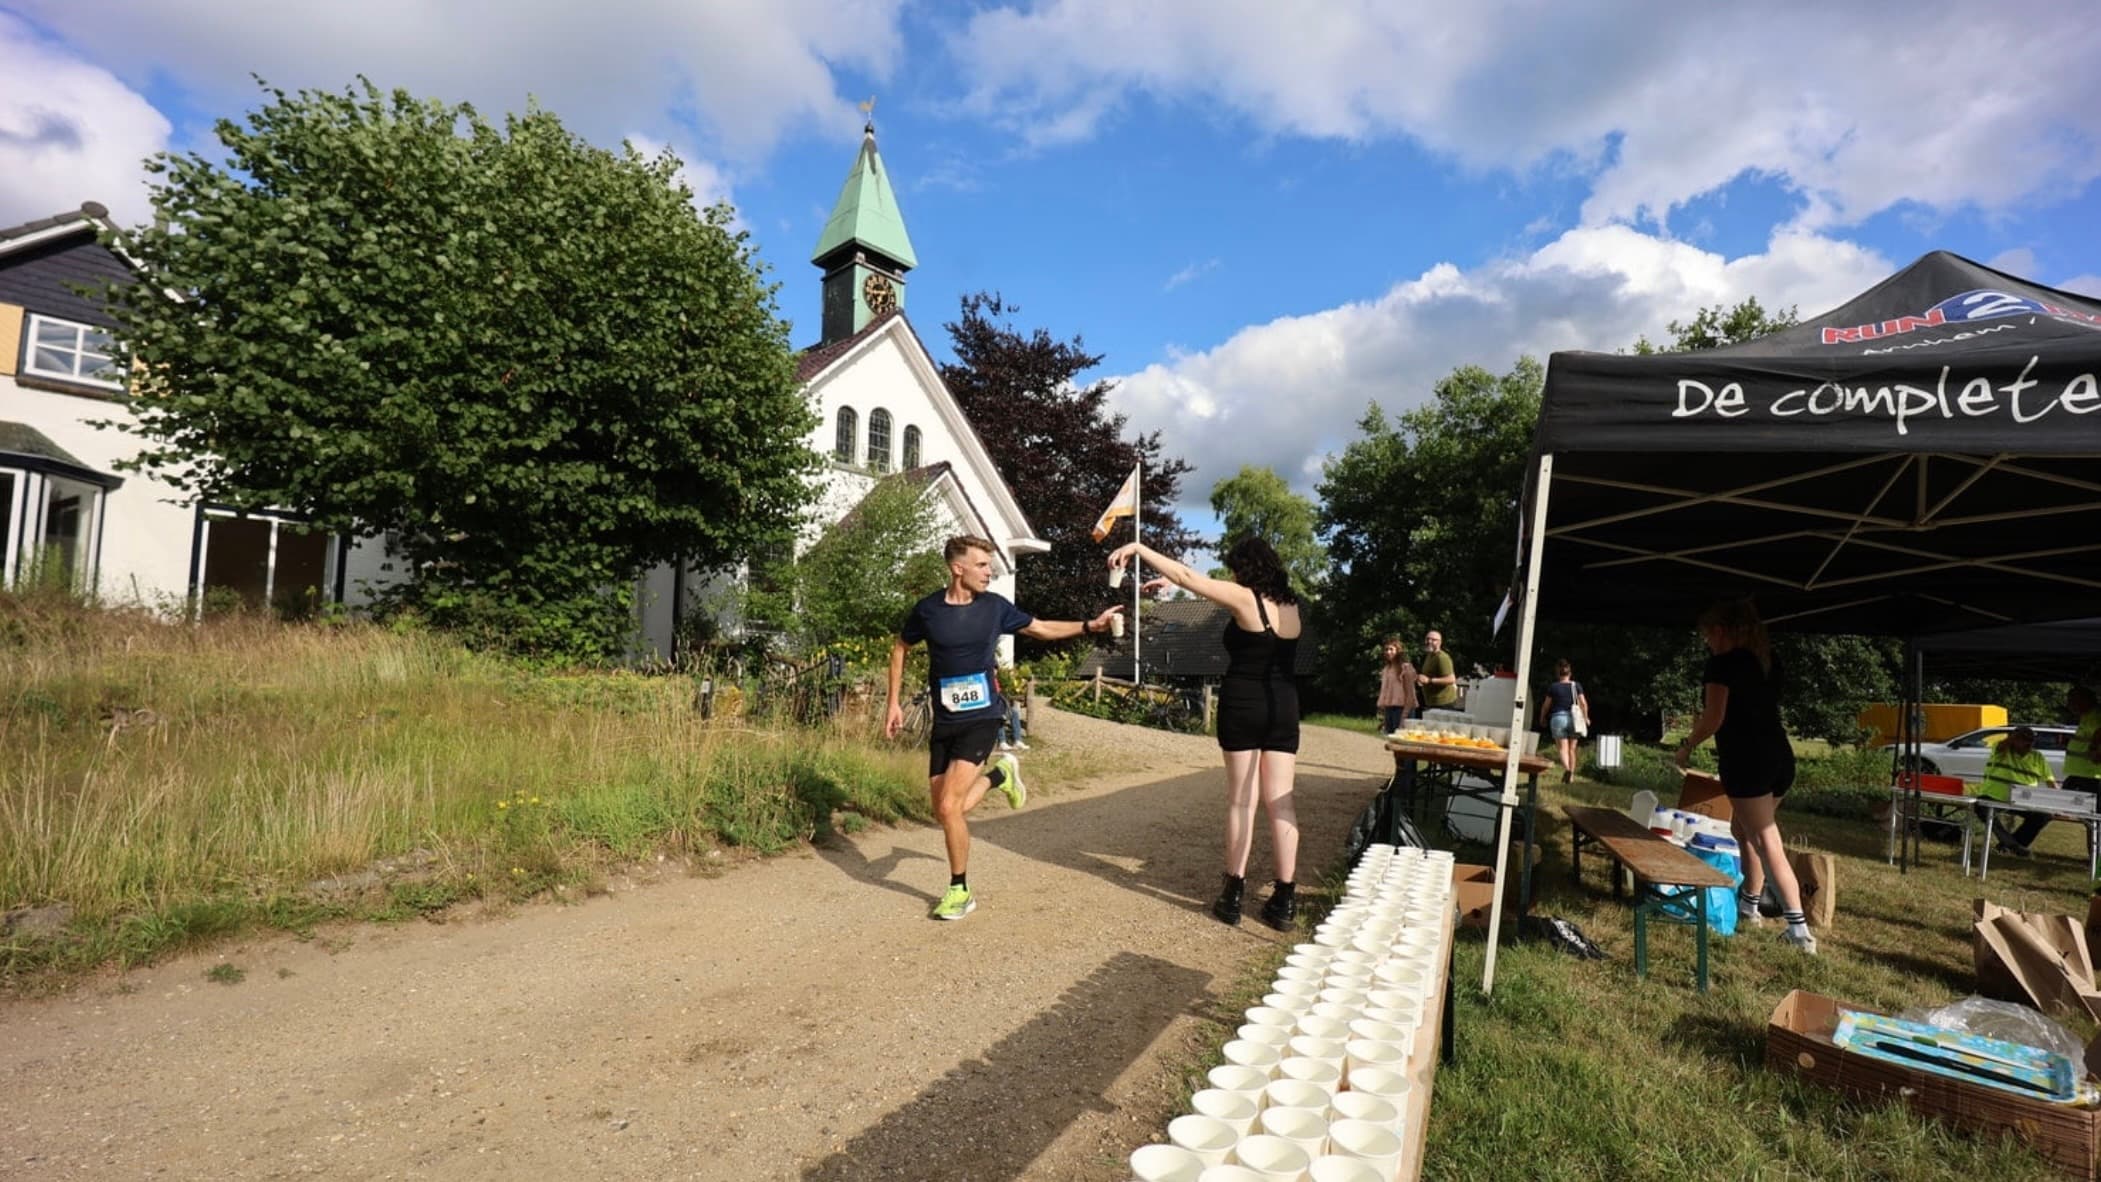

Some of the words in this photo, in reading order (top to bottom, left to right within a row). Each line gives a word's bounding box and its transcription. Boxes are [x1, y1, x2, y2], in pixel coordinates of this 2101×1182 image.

[1822, 308, 1947, 344] RUN
[1672, 379, 1751, 418] De
[1769, 355, 2101, 436] complete
[952, 690, 979, 704] 848
